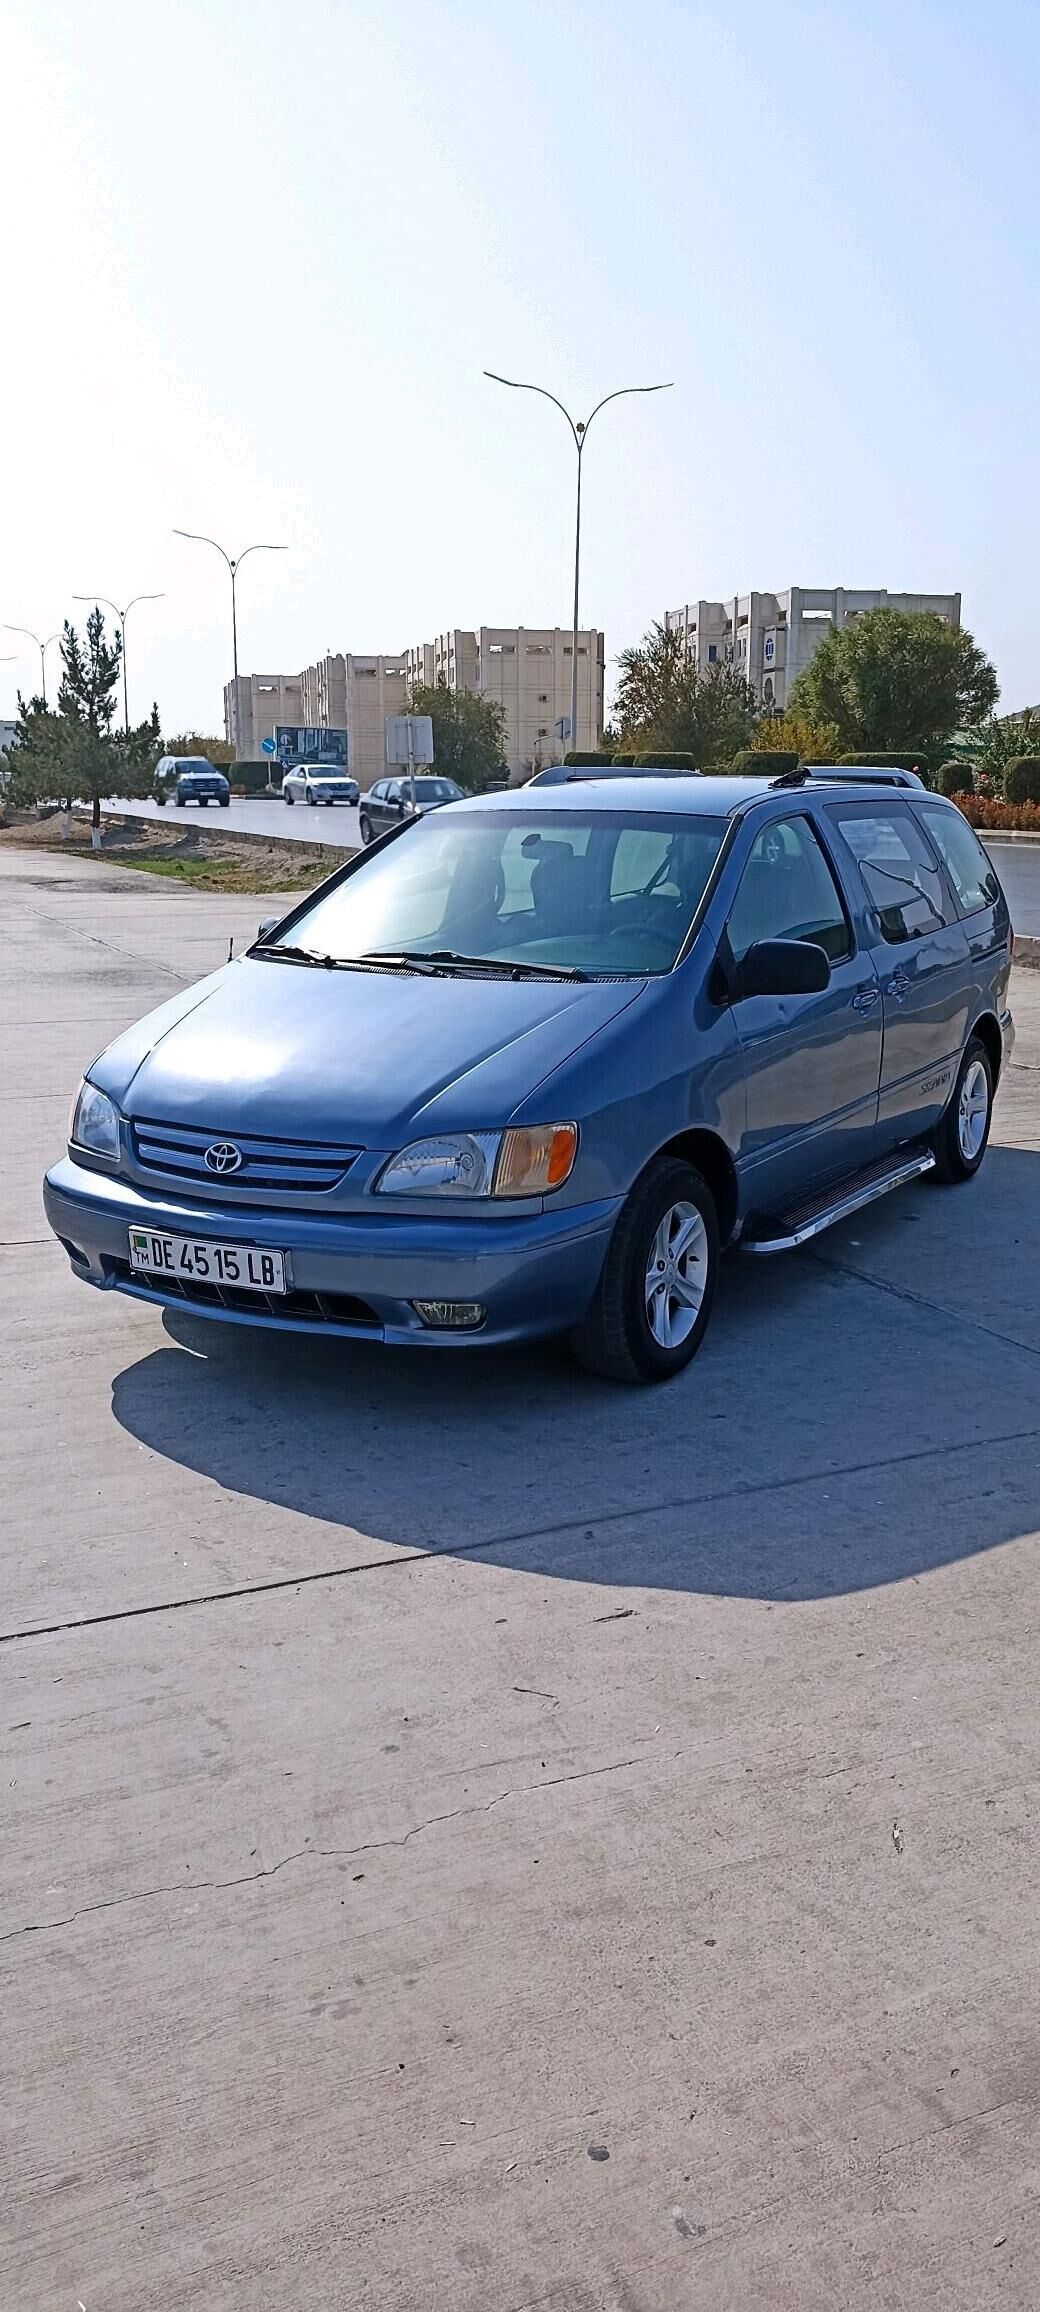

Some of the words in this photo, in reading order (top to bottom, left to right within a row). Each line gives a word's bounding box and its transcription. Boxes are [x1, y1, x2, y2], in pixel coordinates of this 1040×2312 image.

[135, 1251, 150, 1265] TM
[151, 1237, 176, 1270] DE
[180, 1243, 210, 1276] 45
[213, 1248, 240, 1281] 15
[247, 1253, 275, 1286] LB
